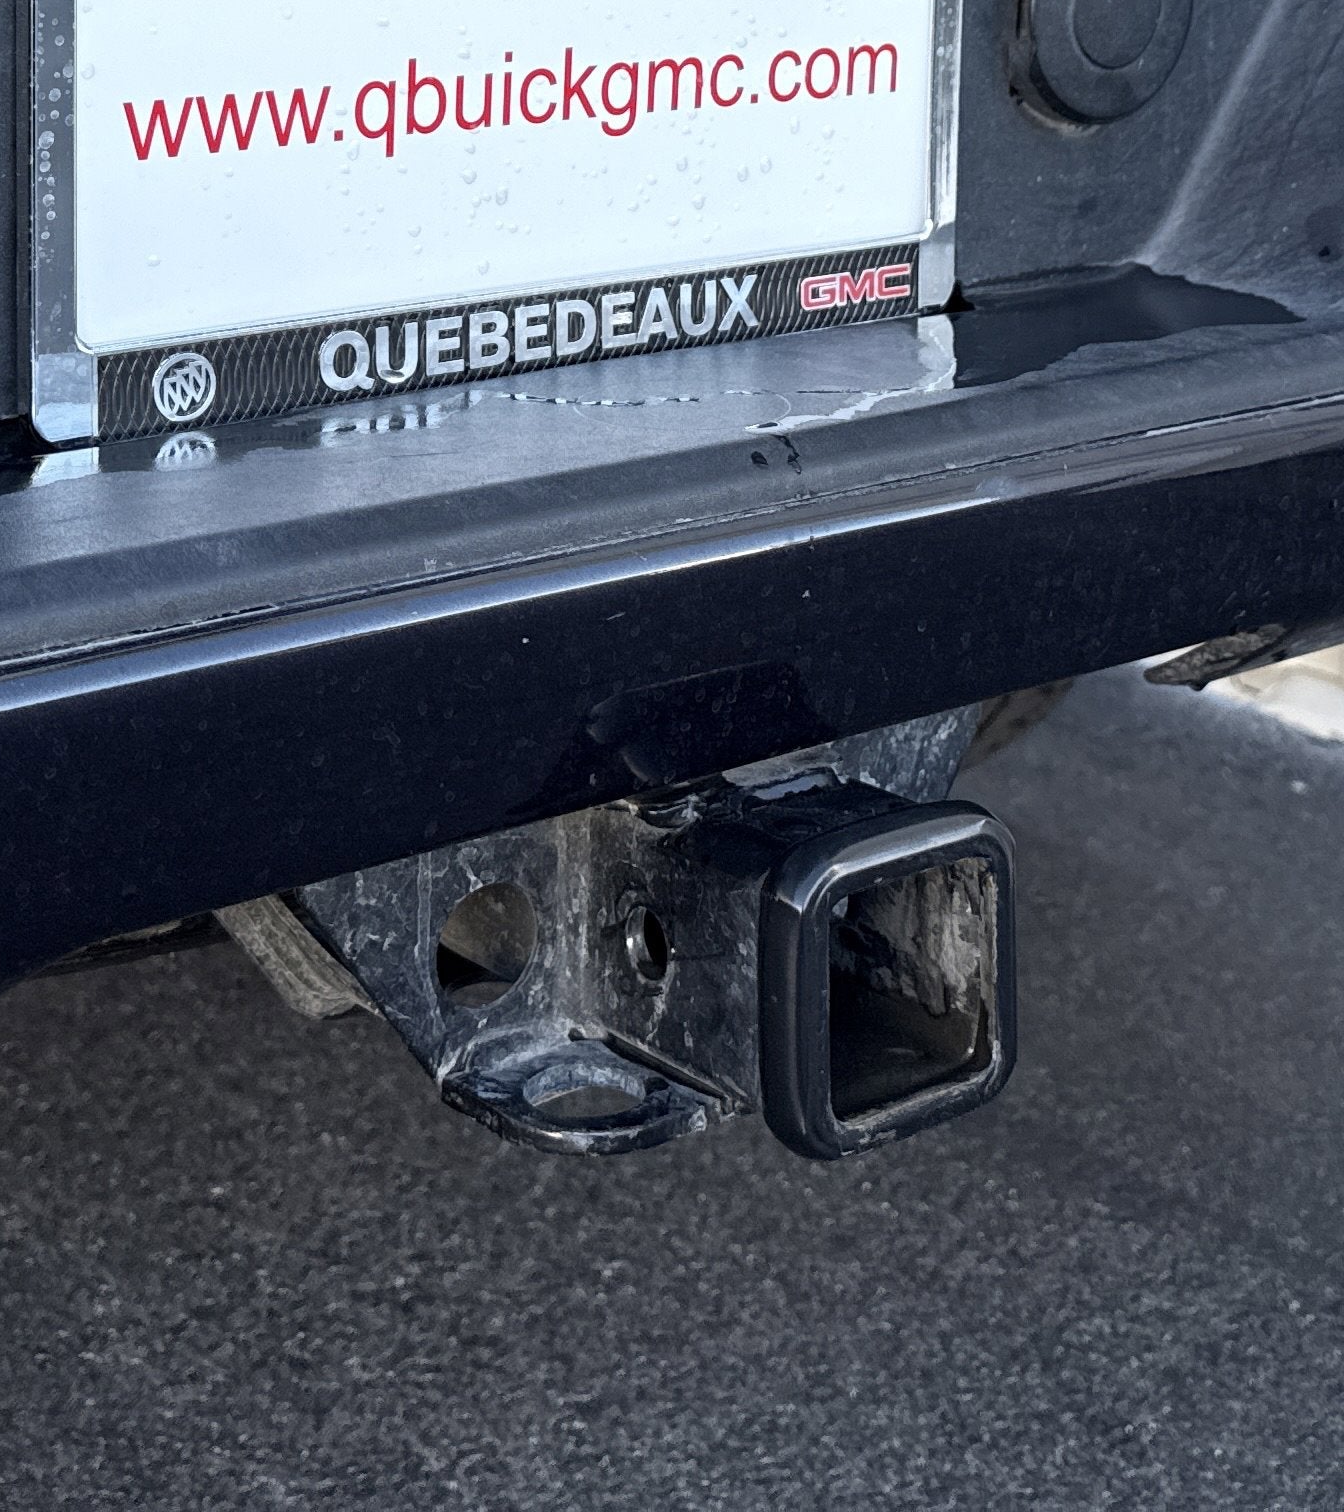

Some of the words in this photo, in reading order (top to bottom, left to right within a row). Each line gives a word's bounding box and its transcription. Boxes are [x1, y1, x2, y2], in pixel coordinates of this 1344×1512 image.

[125, 44, 896, 160] www.qbuickgmc.com
[318, 272, 761, 392] QUEBEDEAUX
[797, 264, 912, 312] GMC
